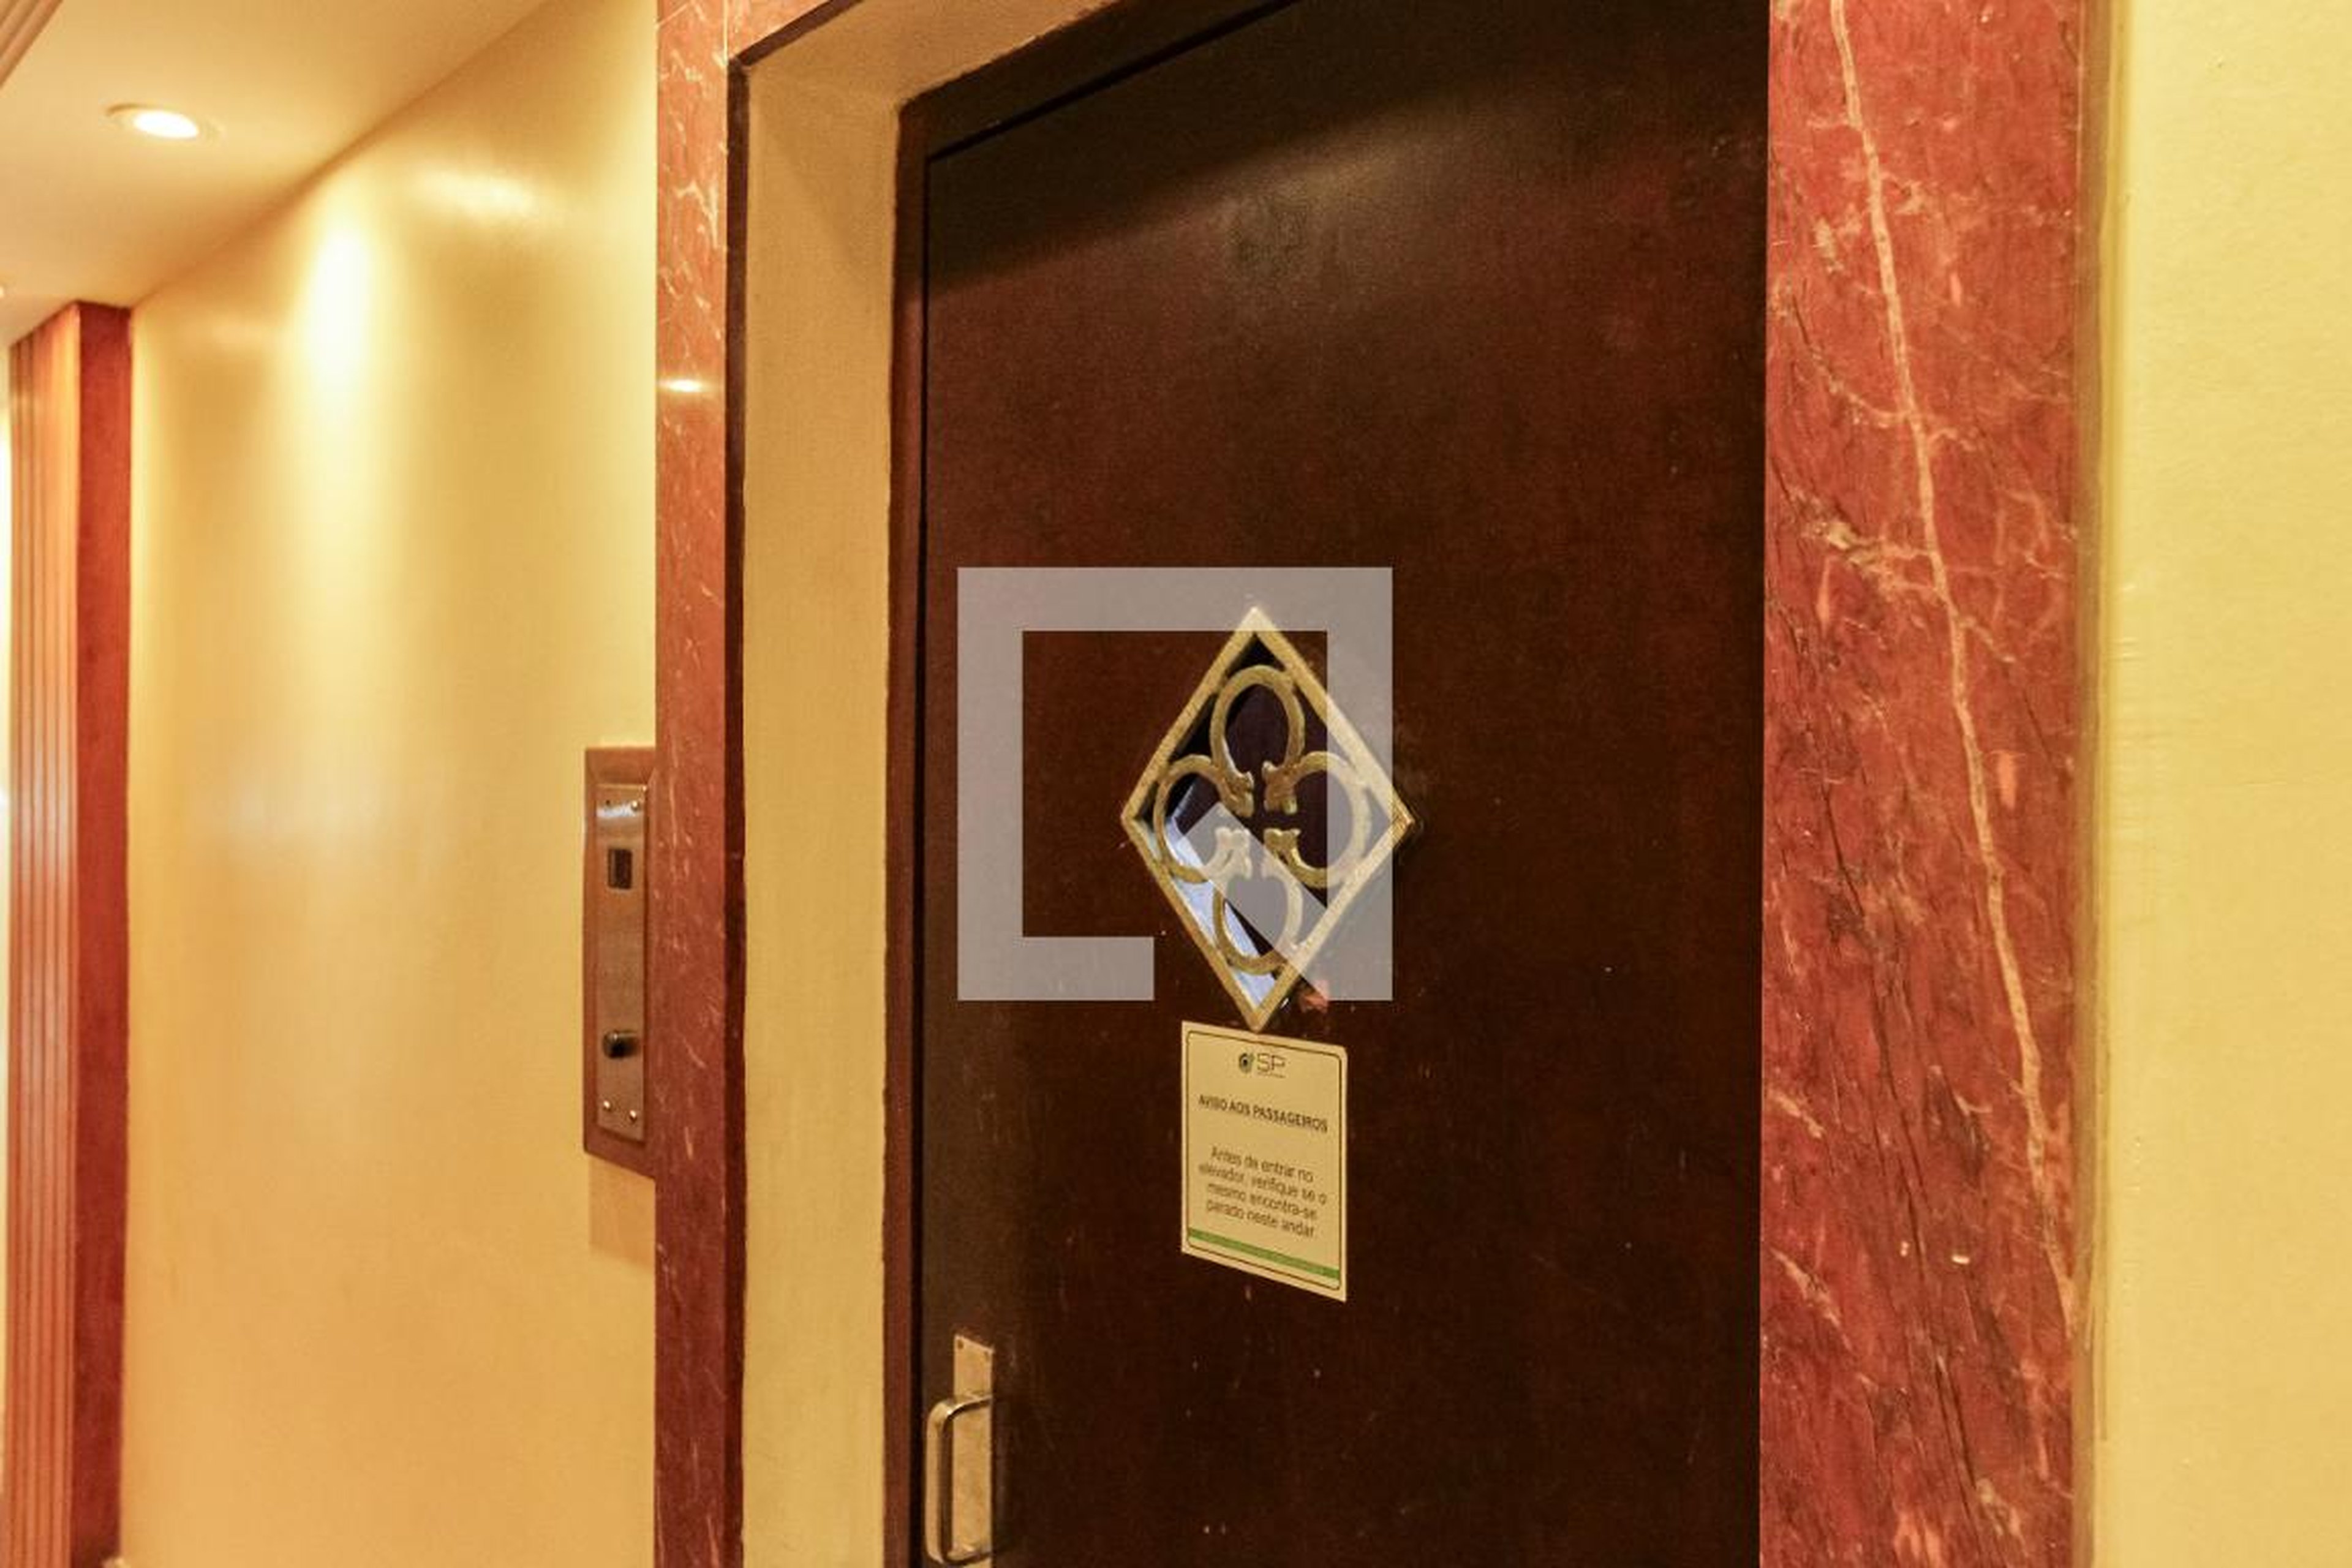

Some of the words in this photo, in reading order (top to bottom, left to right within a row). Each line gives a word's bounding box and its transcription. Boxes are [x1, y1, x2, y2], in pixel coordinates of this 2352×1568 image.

[1198, 1095, 1226, 1110] AVISO
[1229, 1100, 1250, 1116] AOS
[1253, 1106, 1328, 1132] PASSAGEIROS
[1212, 1147, 1242, 1164] Antes
[1245, 1155, 1258, 1169] de
[1261, 1161, 1295, 1177] entrar
[1298, 1169, 1313, 1182] no
[1207, 1183, 1246, 1202] mesmo
[1250, 1194, 1317, 1221] encontra-se
[1253, 1176, 1298, 1198] verifique
[1302, 1189, 1315, 1202] se
[1319, 1194, 1327, 1205] o
[1207, 1199, 1245, 1220] parado
[1247, 1210, 1278, 1229] neste
